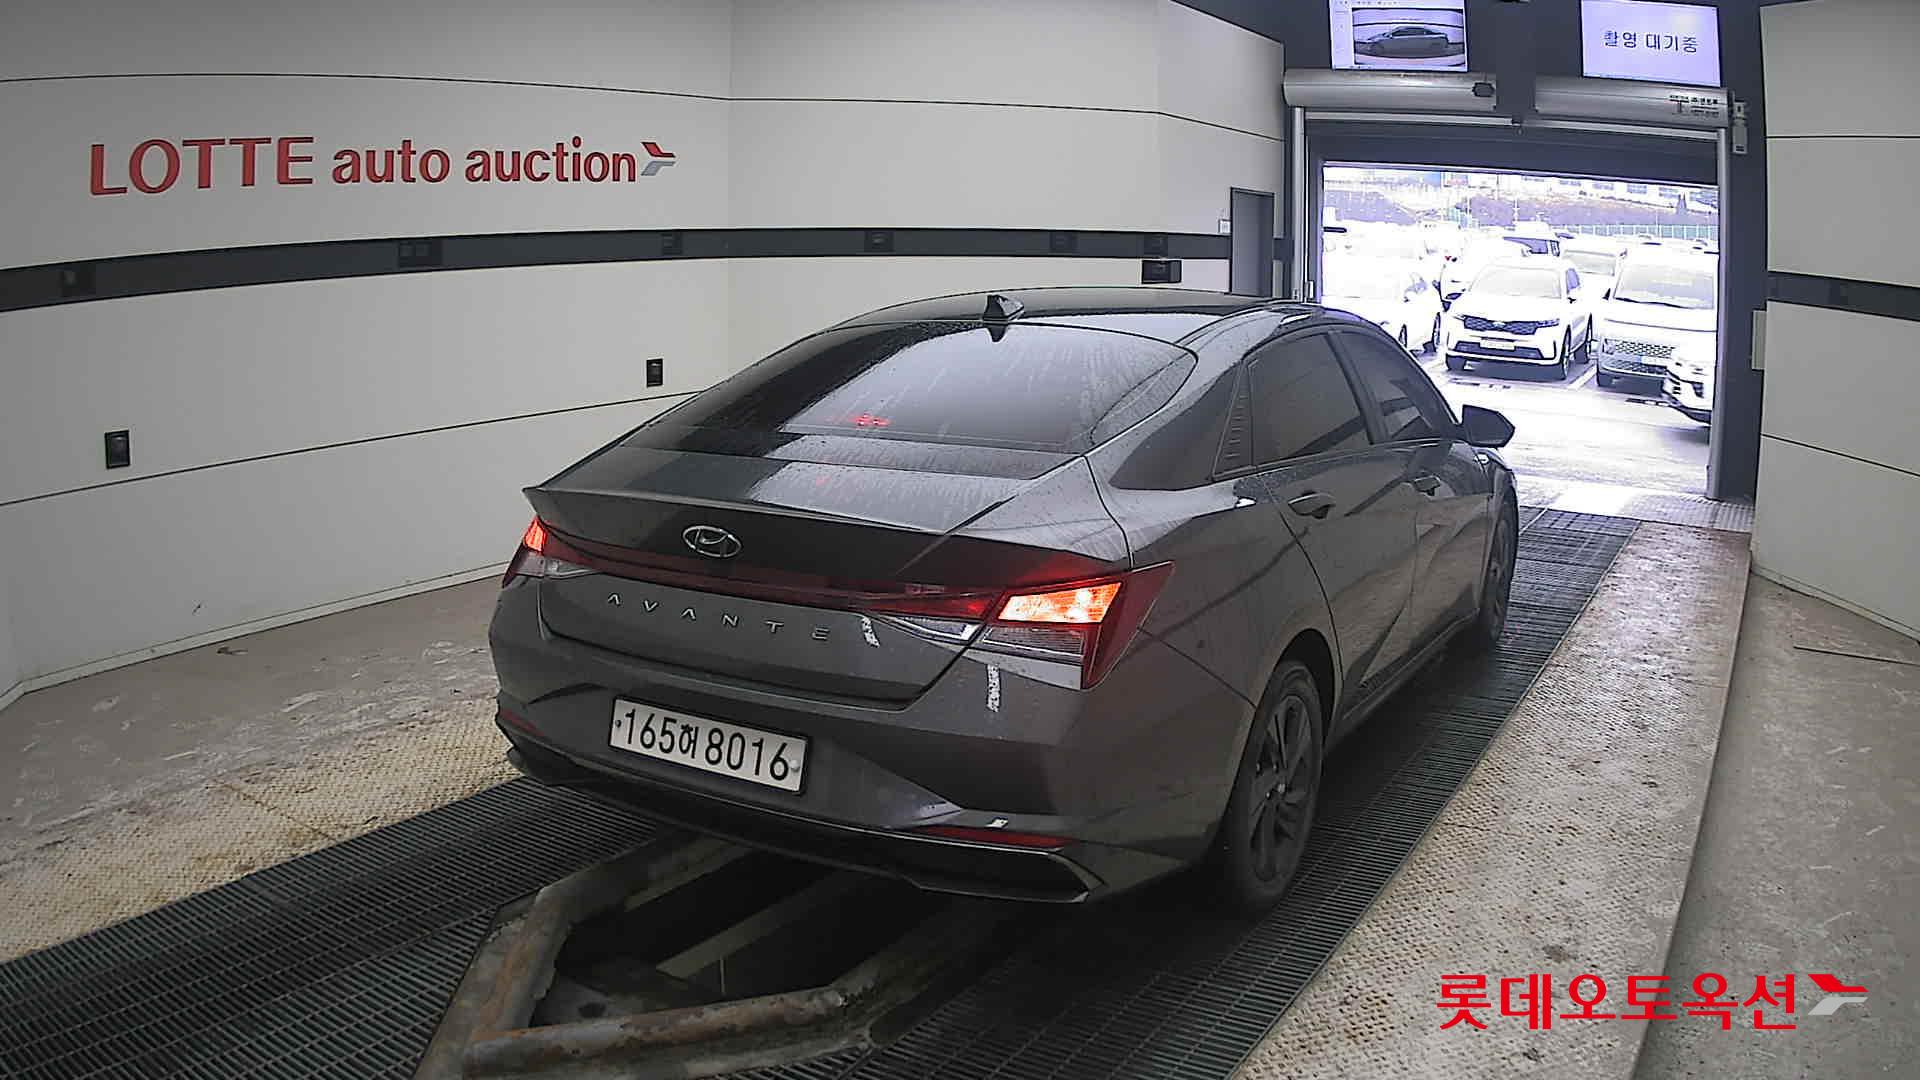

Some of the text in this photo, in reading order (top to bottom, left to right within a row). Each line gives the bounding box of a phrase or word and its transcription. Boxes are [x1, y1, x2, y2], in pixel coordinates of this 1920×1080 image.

[1603, 31, 1699, 53] 촬영 대기중
[89, 136, 638, 196] LOTTE auto auction
[607, 592, 831, 641] AVANTE
[624, 708, 789, 781] 165허8016
